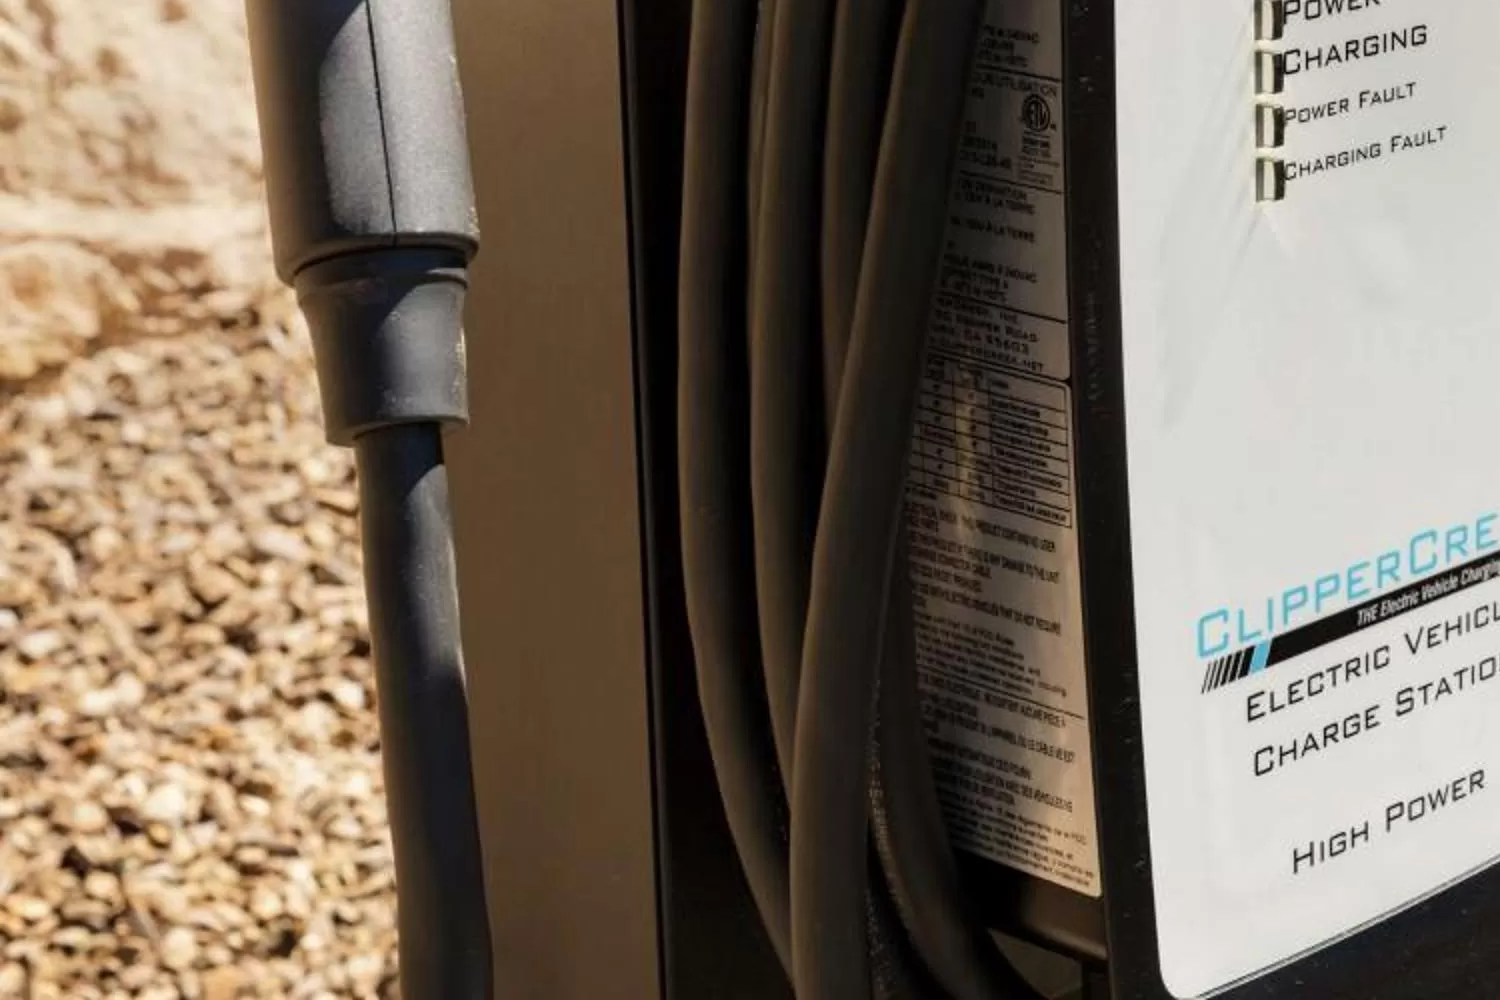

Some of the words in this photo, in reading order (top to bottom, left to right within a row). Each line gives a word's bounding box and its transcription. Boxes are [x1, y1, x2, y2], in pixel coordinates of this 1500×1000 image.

[1282, 24, 1428, 76] CHARGING
[1284, 98, 1349, 128] POWER
[1359, 81, 1417, 109] FAULT
[1284, 143, 1381, 182] CHARGING
[1390, 126, 1447, 153] FAULT
[1357, 602, 1378, 626] THE
[1380, 588, 1420, 617] Electric
[1421, 575, 1459, 599] Vehicle
[1247, 645, 1391, 723] ELECTRIC
[1254, 704, 1380, 777] CHARGE
[1293, 822, 1370, 875] HIGH
[1386, 769, 1485, 832] POWER
